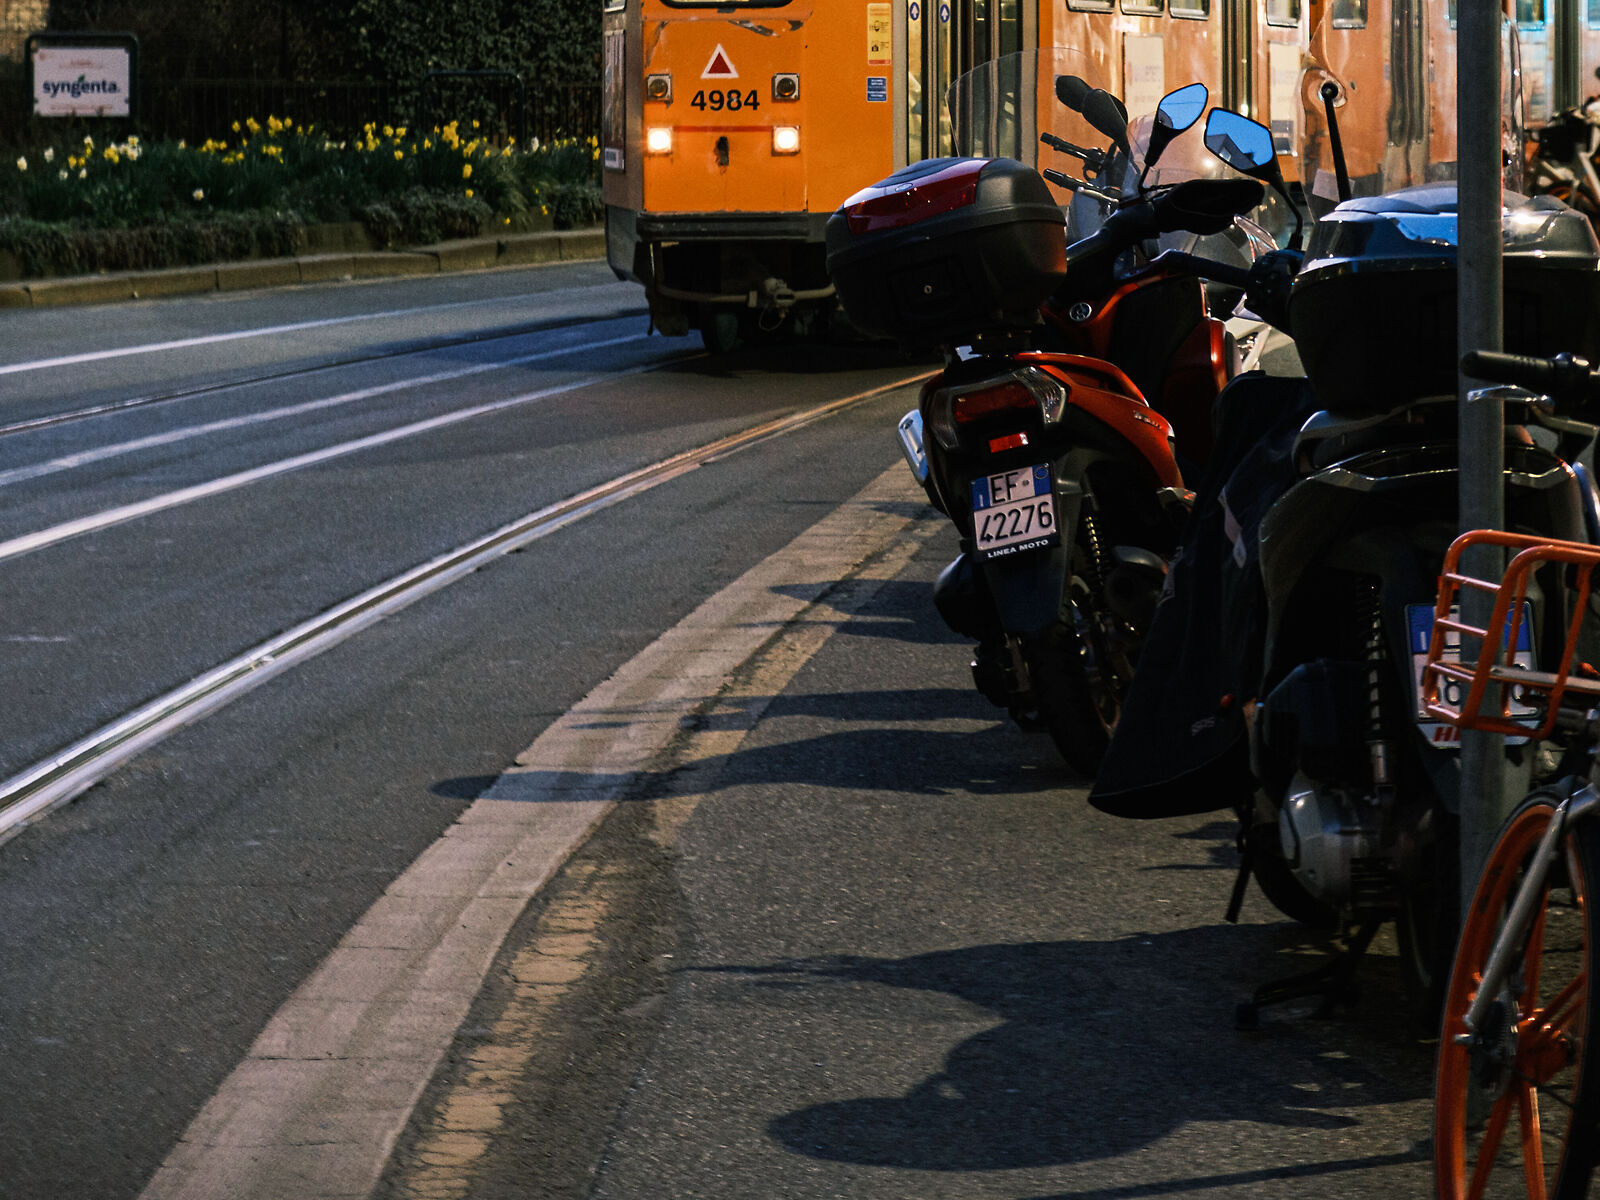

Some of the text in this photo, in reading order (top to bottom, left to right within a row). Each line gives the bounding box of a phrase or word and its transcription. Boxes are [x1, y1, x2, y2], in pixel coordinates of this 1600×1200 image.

[43, 79, 117, 98] syngenta
[690, 89, 760, 111] 4984
[990, 471, 1019, 504] EF
[980, 501, 1053, 542] 42276
[987, 539, 1049, 558] LINEA MOTO
